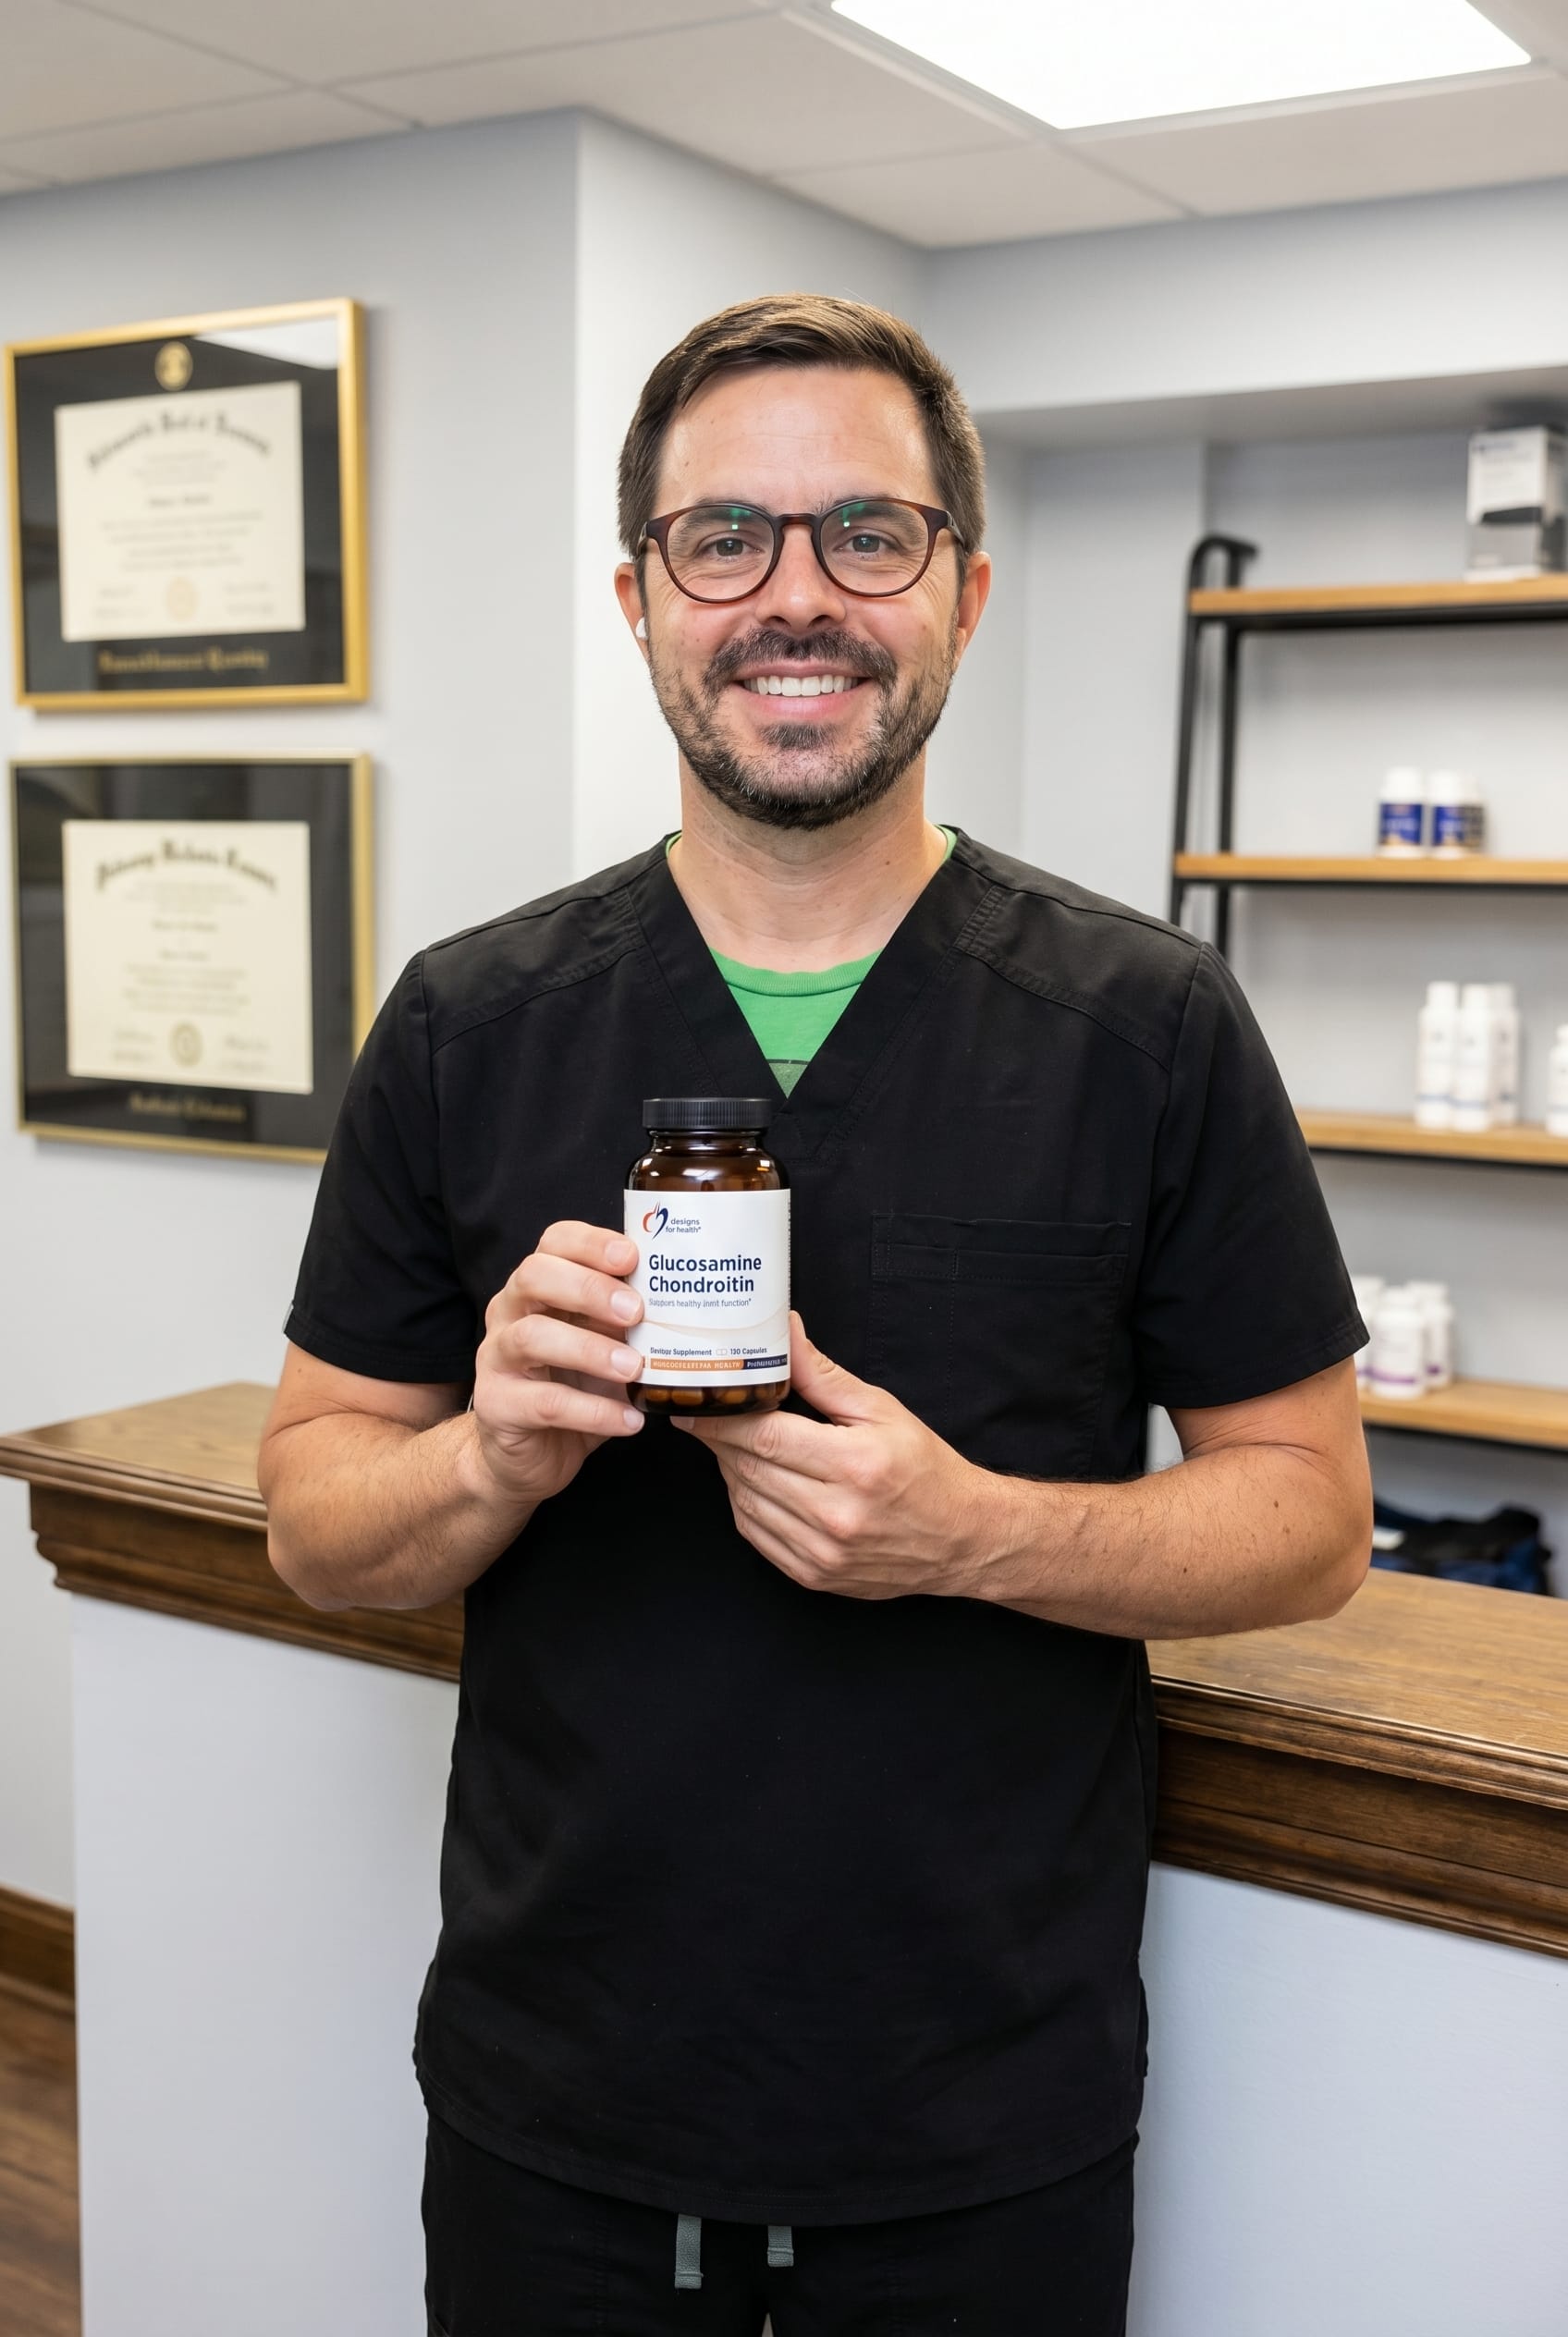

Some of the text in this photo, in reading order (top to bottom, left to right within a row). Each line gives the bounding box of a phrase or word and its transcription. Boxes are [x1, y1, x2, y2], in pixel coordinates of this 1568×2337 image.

[670, 1217, 700, 1226] designs
[649, 1254, 762, 1271] Glucosamine
[649, 1276, 754, 1292] Chondroitin
[676, 1299, 701, 1309] healthy
